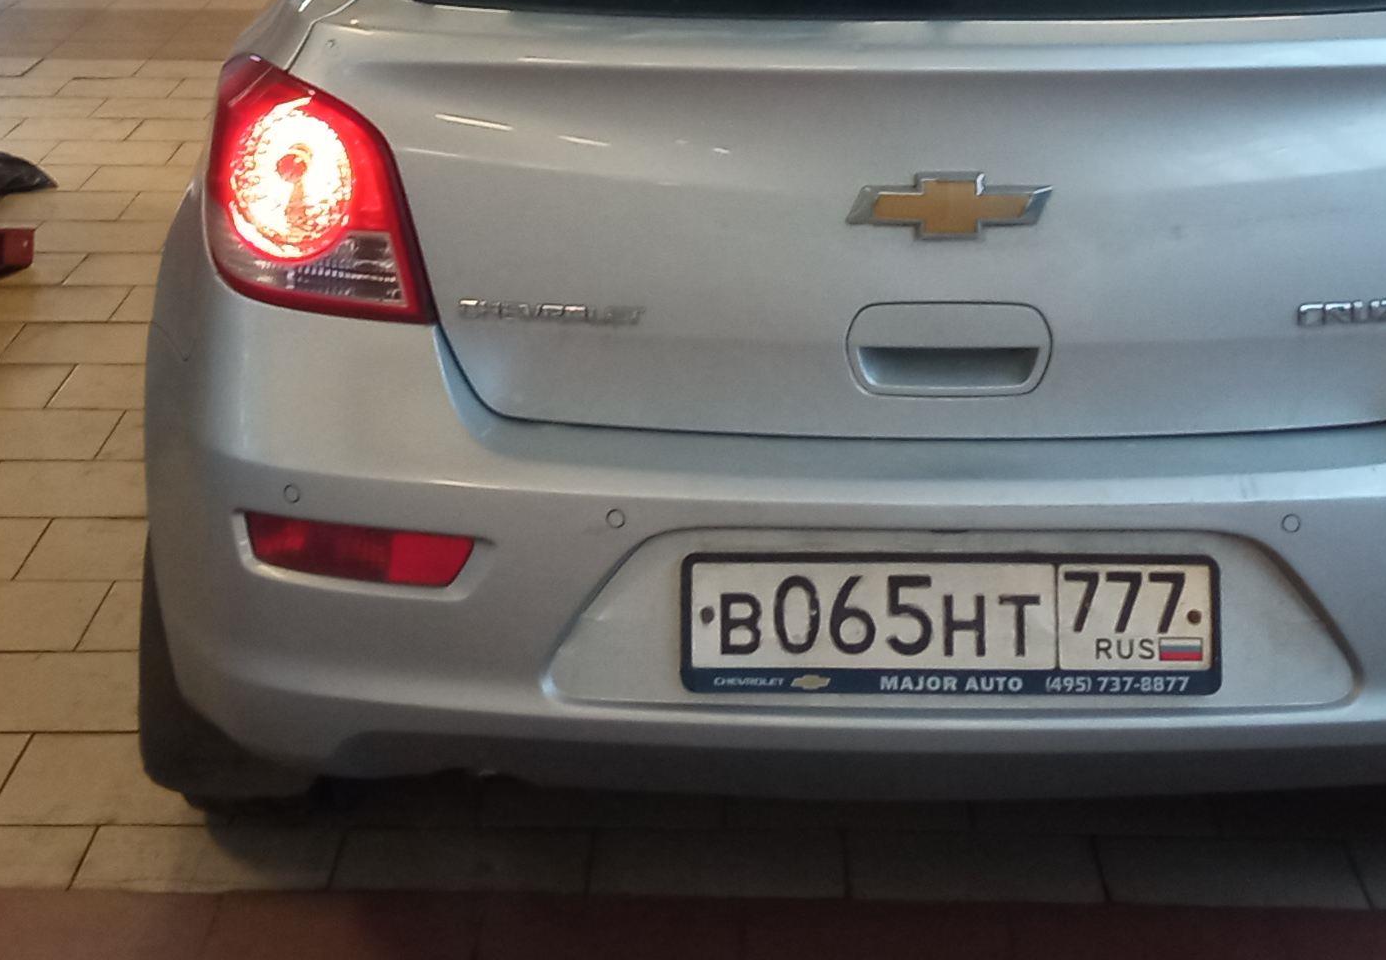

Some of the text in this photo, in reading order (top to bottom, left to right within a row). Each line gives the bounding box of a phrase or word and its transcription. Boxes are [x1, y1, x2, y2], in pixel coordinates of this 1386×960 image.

[1063, 571, 1187, 634] 777
[1095, 638, 1156, 660] RUS
[713, 674, 1190, 694] CHEVROLET MAJOR AUTO (495) 737-8877
